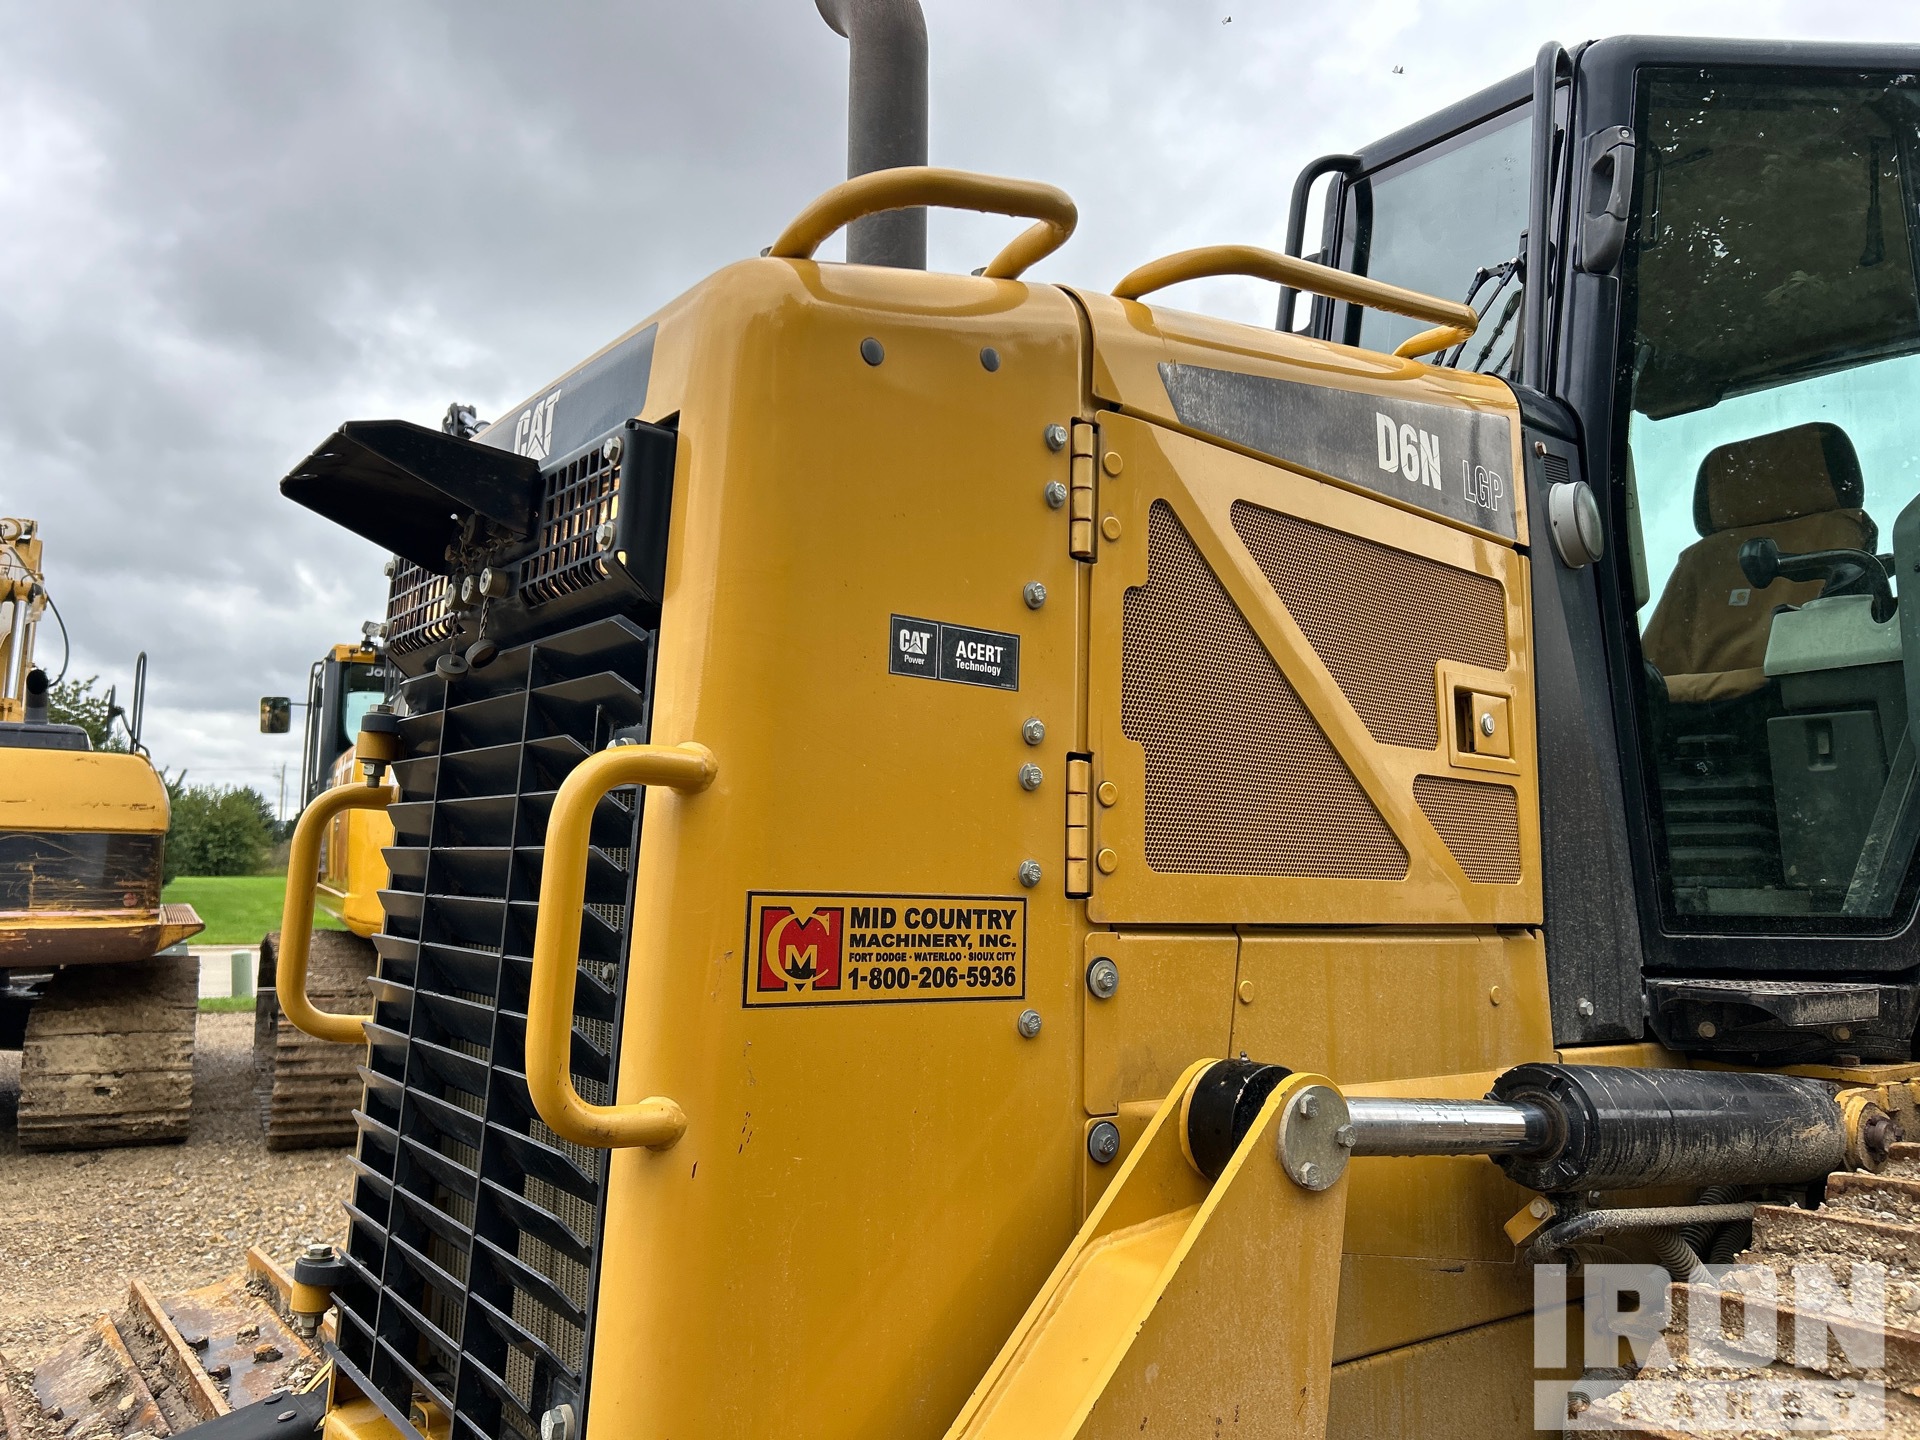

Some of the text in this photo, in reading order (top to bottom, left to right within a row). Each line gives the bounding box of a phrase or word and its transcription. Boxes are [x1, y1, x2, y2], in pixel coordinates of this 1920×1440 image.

[514, 389, 562, 461] CAT
[1376, 411, 1504, 511] D6N LGP
[899, 629, 931, 655] CAT
[955, 640, 1003, 664] ACERT
[904, 654, 926, 666] Power
[955, 658, 1002, 677] Technology
[850, 907, 1017, 930] MID COUNTRY
[849, 934, 1017, 951] MACHINERY, INC.
[849, 951, 1016, 963] FORT DODGE WATERLOO SIOUX CITY
[848, 965, 1016, 990] 1-800-206-5936
